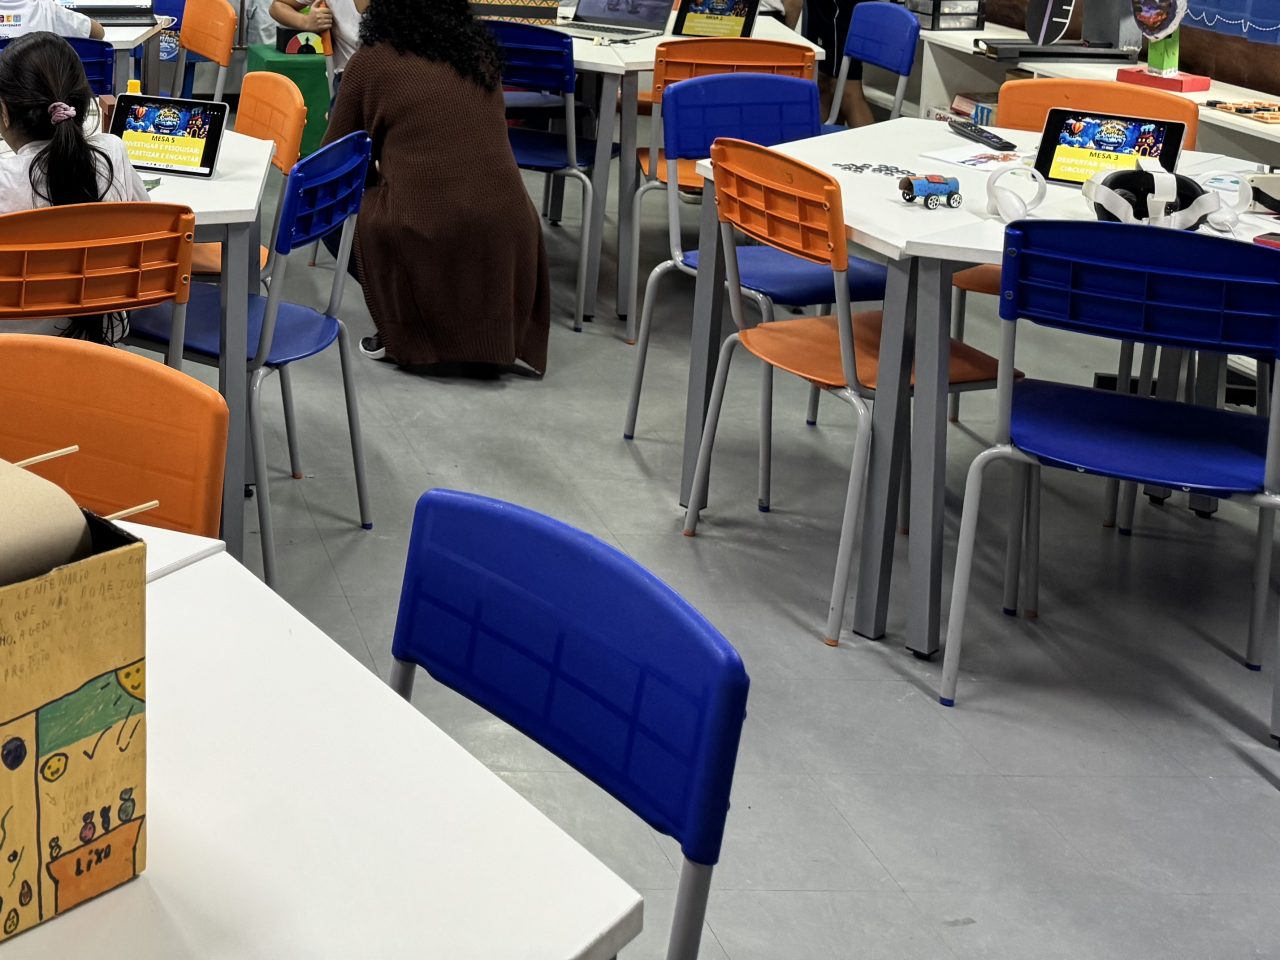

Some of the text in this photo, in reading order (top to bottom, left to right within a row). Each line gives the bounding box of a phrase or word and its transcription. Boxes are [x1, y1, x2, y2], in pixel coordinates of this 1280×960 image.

[151, 135, 171, 143] MESA
[1089, 151, 1112, 160] MESA
[1055, 156, 1099, 167] DESPERTAR
[74, 843, 112, 877] Lixo
